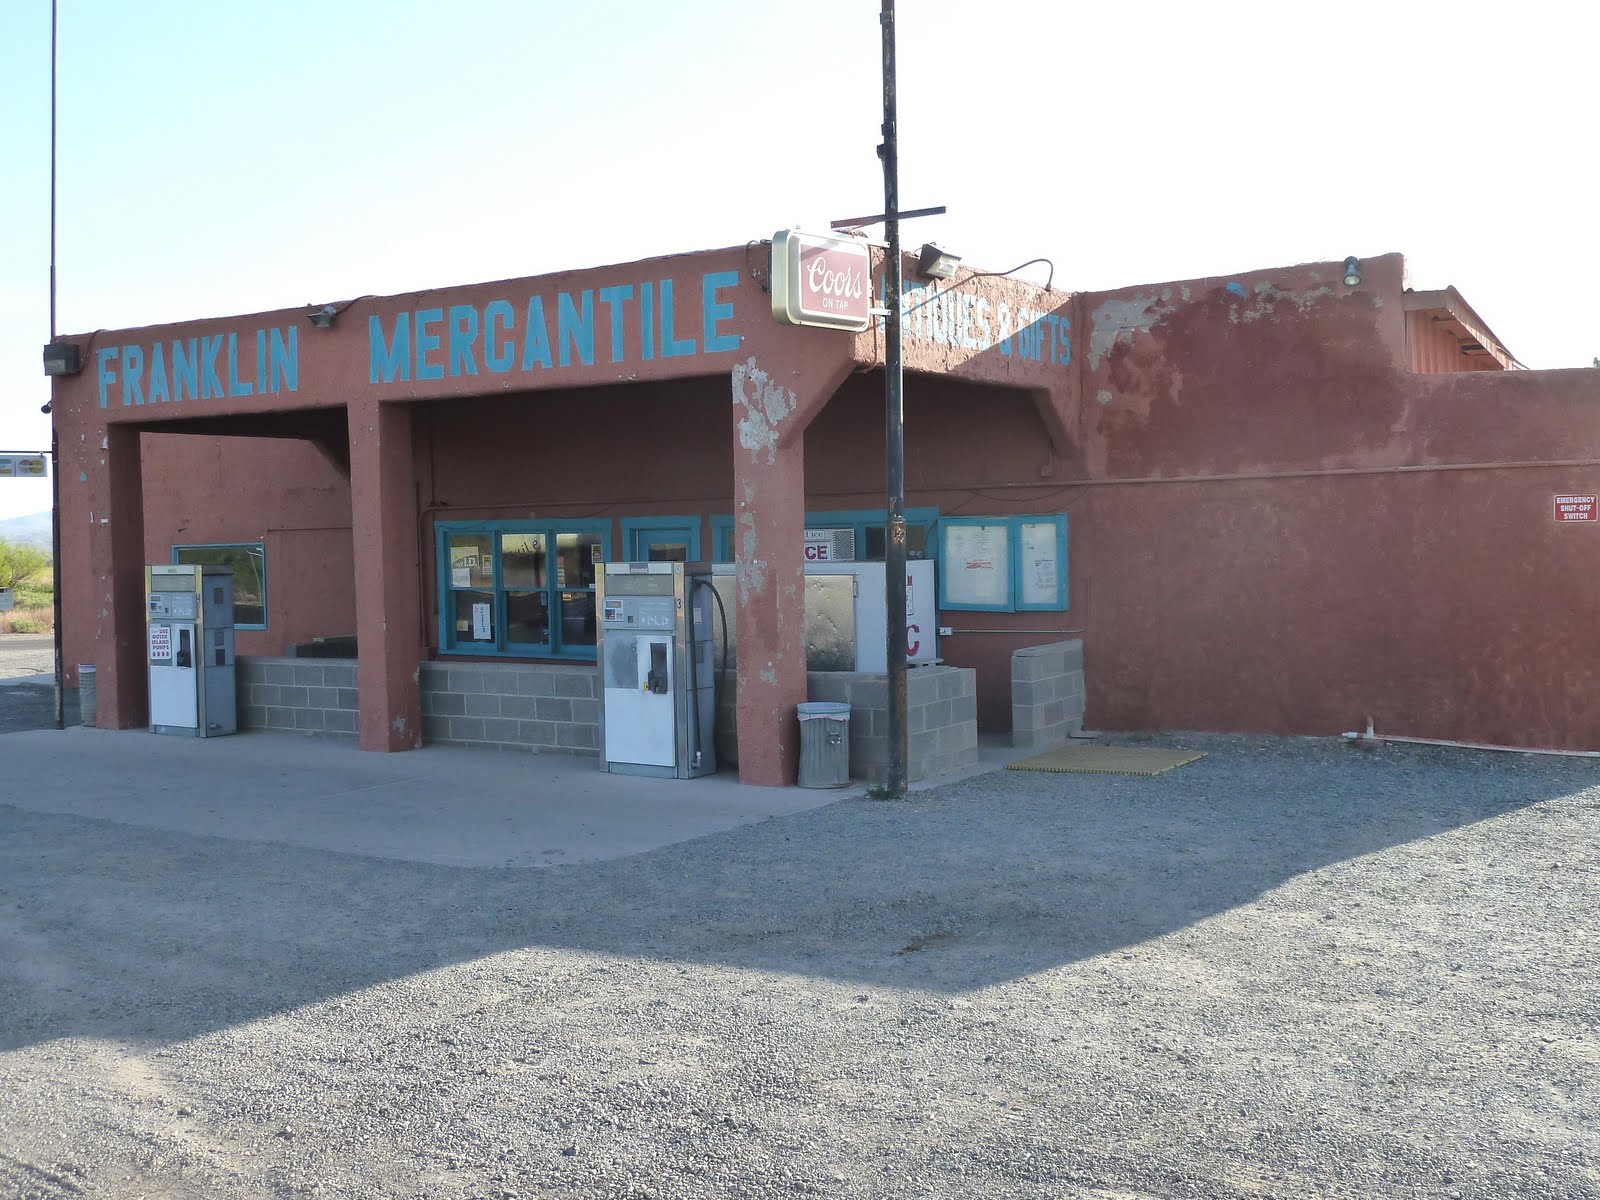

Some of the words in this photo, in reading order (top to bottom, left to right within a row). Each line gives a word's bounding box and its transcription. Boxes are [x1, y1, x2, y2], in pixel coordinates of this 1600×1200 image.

[807, 256, 863, 299] Coors
[823, 298, 833, 308] ON
[836, 299, 849, 309] TAP
[97, 325, 298, 409] FRANKLIN
[369, 271, 740, 384] MERCANTILE
[998, 303, 1013, 358] &
[1018, 307, 1071, 367] GIFTS
[804, 544, 828, 560] CE
[676, 598, 682, 609] 3
